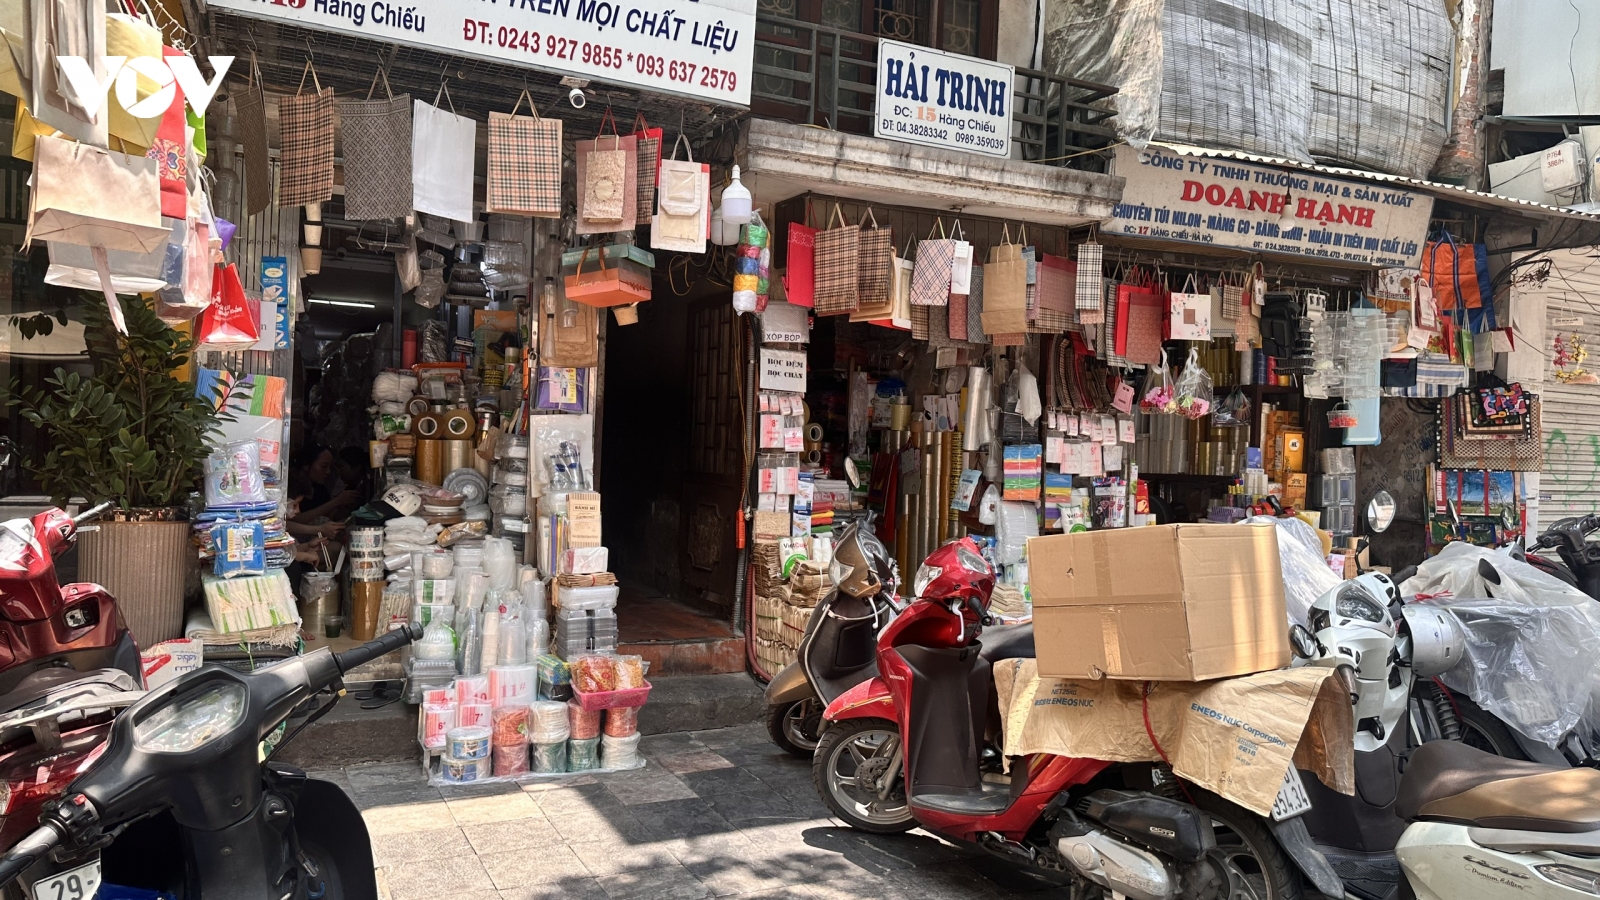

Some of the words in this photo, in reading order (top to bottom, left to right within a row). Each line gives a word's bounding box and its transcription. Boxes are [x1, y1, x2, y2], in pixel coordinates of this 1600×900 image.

[371, 1, 426, 33] Chiếu
[576, 0, 620, 31] MỌI
[625, 9, 686, 42] CHẤT
[691, 20, 739, 55] LIỆU
[463, 18, 493, 45] ĐT:
[497, 26, 540, 54] 0243
[546, 35, 578, 61] 927
[669, 60, 697, 84] 637
[700, 66, 737, 92] 2579
[885, 51, 930, 103] HẢI
[935, 68, 1006, 117] TRINH
[882, 119, 894, 131] ĐT:
[896, 121, 948, 140] 04.38283342
[894, 105, 913, 118] ĐC:
[916, 106, 937, 122] 15
[939, 113, 965, 130] Hàng
[968, 119, 996, 133] Chiếu
[1141, 150, 1184, 170] CÔNG
[1213, 164, 1250, 181] TNHH
[1254, 170, 1308, 190] THƯƠNG
[1313, 181, 1339, 198] MẠI
[1342, 187, 1351, 197] &
[1354, 186, 1380, 202] SẢN
[1381, 191, 1414, 208] XUẤT
[1180, 180, 1287, 214] DOANH
[1295, 197, 1375, 228] HẠNH
[1112, 202, 1152, 222] CHUYÊN
[1154, 206, 1170, 224] TÚI
[1333, 232, 1343, 246] IN
[1380, 236, 1401, 254] CHẤT
[1401, 240, 1418, 260] LIỆU
[1138, 226, 1149, 235] 17
[1190, 702, 1223, 721] ENEOS
[1223, 715, 1243, 728] NUC
[1242, 722, 1287, 748] Corporation
